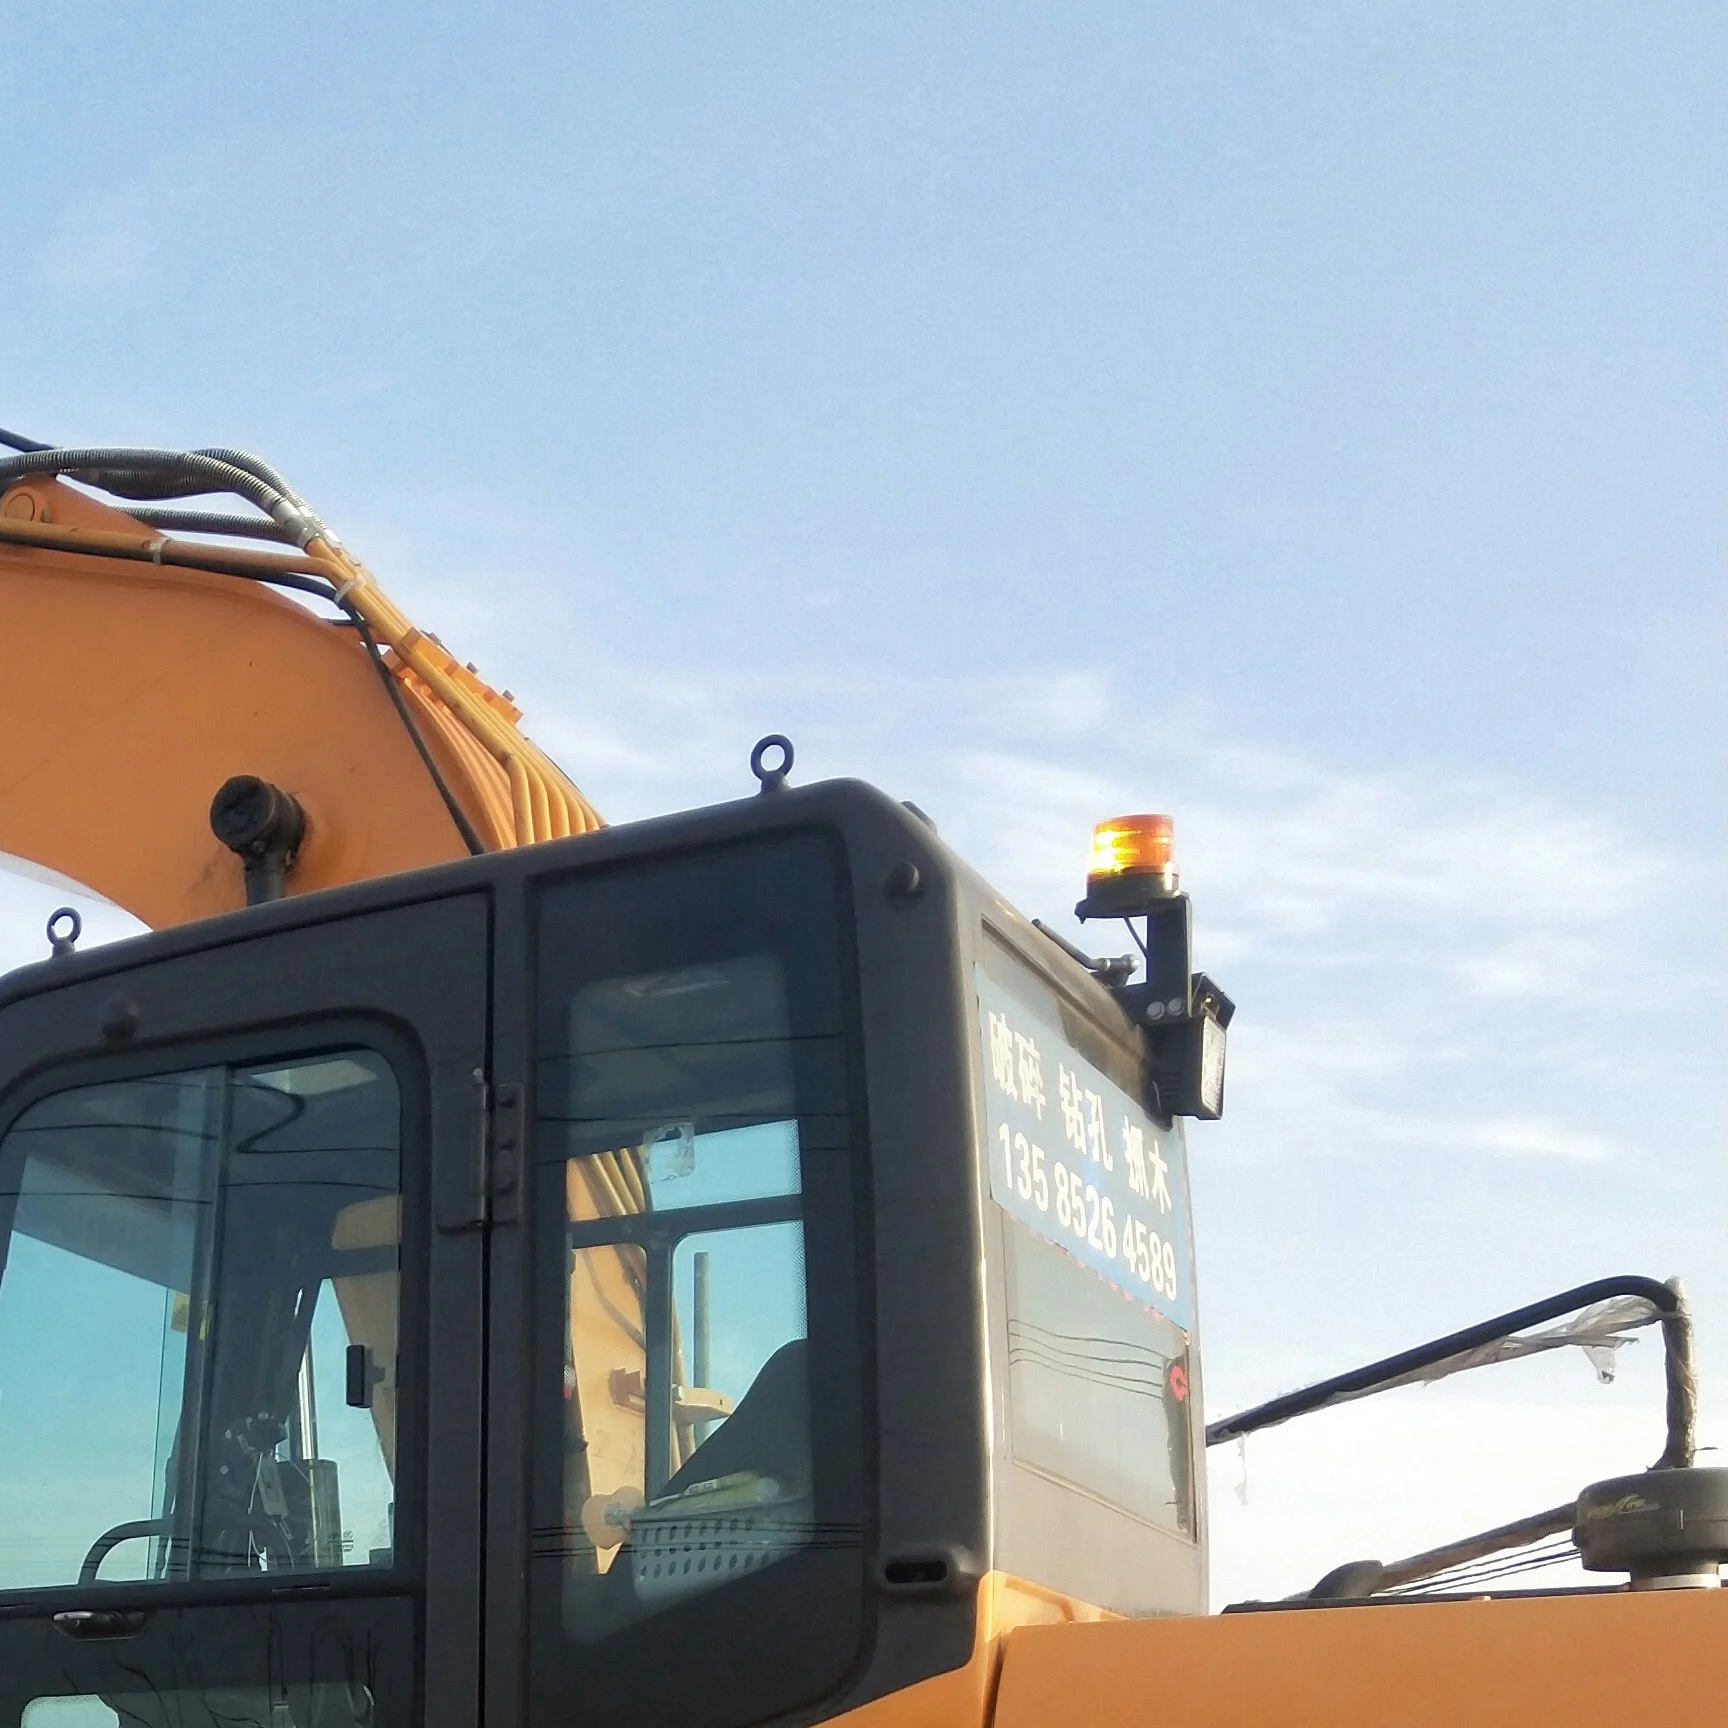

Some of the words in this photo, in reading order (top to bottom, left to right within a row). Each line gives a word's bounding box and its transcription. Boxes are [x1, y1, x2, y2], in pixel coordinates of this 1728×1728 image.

[1059, 1062, 1113, 1172] 钻孔
[998, 1122, 1049, 1212] 135
[1054, 1161, 1117, 1259] 8526
[1122, 1213, 1177, 1301] 4589
